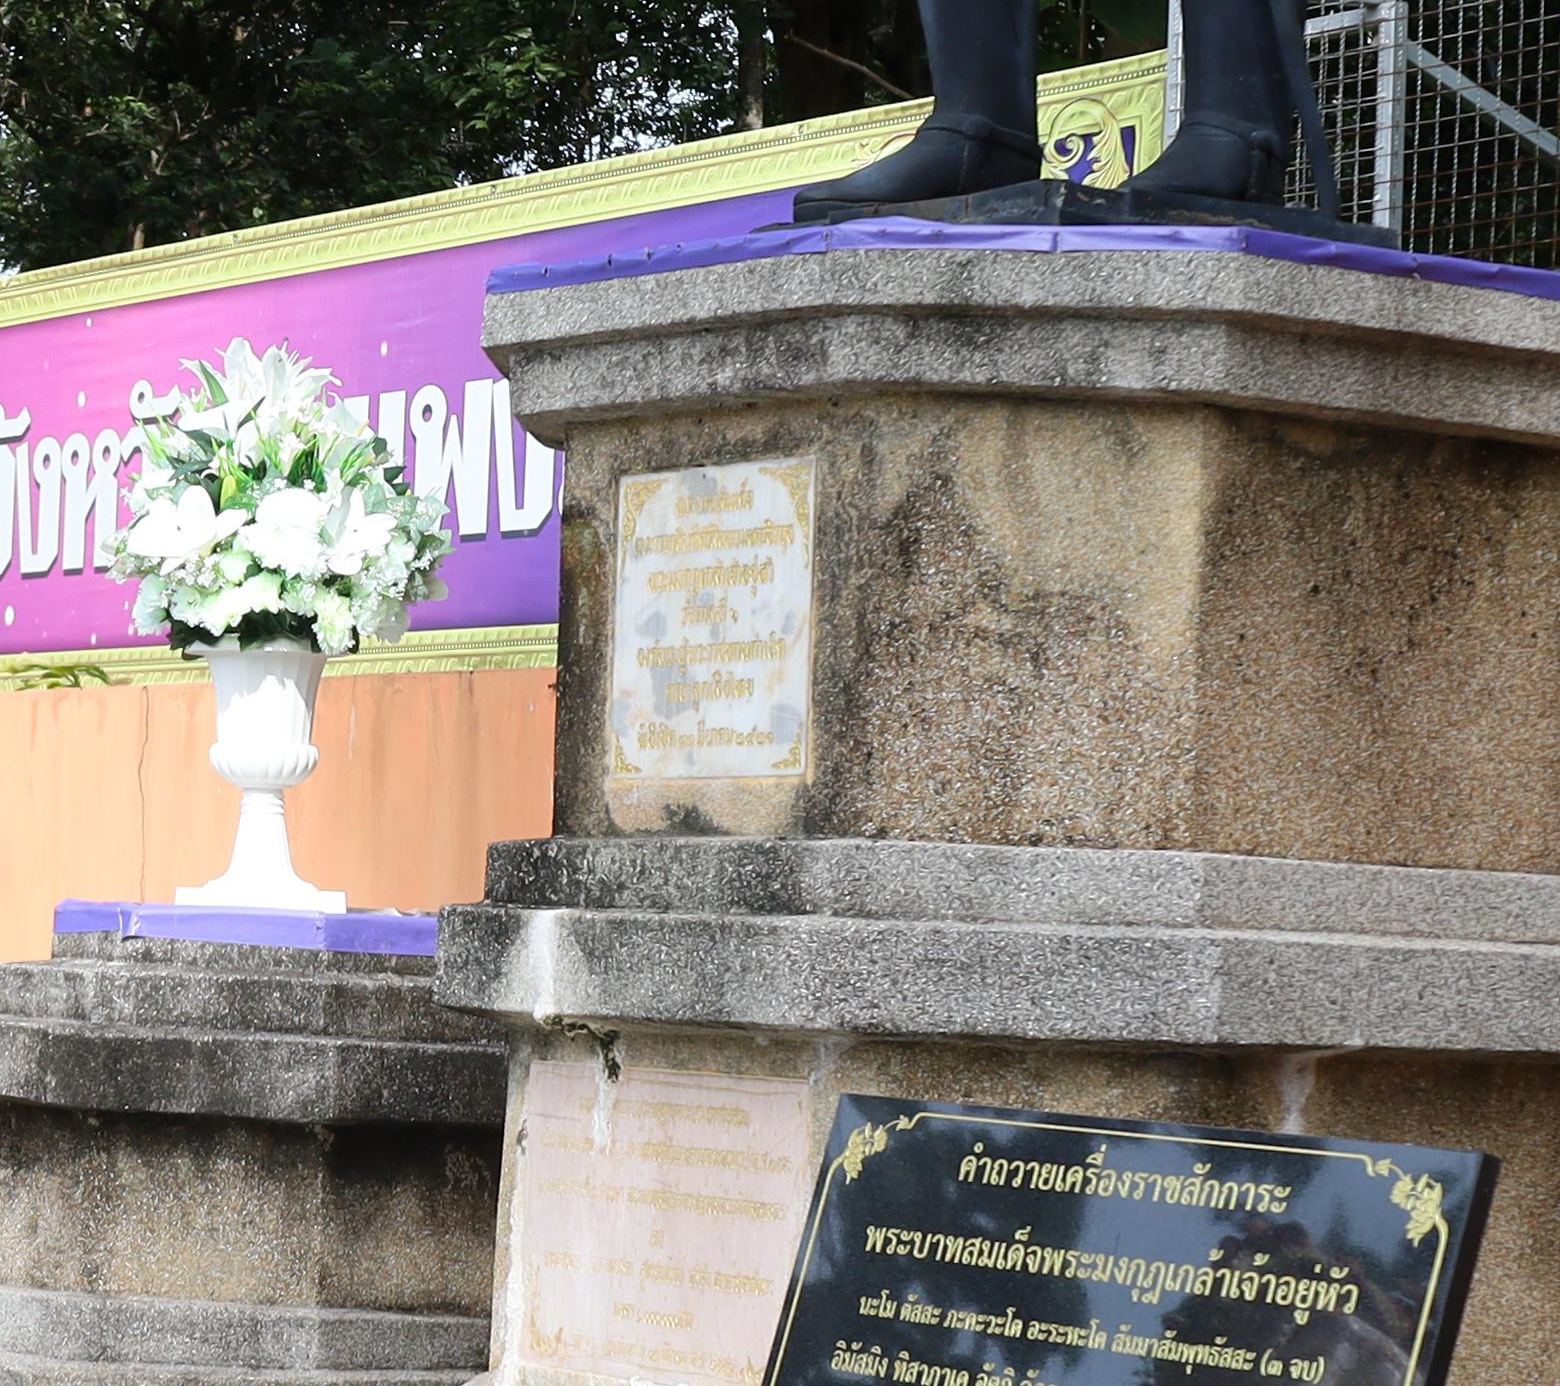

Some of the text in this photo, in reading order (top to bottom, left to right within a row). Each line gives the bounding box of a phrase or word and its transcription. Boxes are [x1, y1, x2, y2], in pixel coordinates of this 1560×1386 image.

[957, 1143, 1292, 1214] คำถวายเครื่องราชสักการะ
[864, 1224, 1359, 1324] พระบาทสมเด็จพระมงกุฎเกล้าเจ้าอยู่หัว
[830, 1339, 890, 1379] อิมัสมิง
[859, 1289, 898, 1318] นะโม
[899, 1293, 943, 1325] ตัสสะ
[943, 1307, 1024, 1338] ภะคะวะโต
[1027, 1319, 1108, 1350] อะระหะโต
[1111, 1324, 1258, 1374] สัมมาสัมพุทธัสสะ
[1289, 1356, 1326, 1384] จบ)
